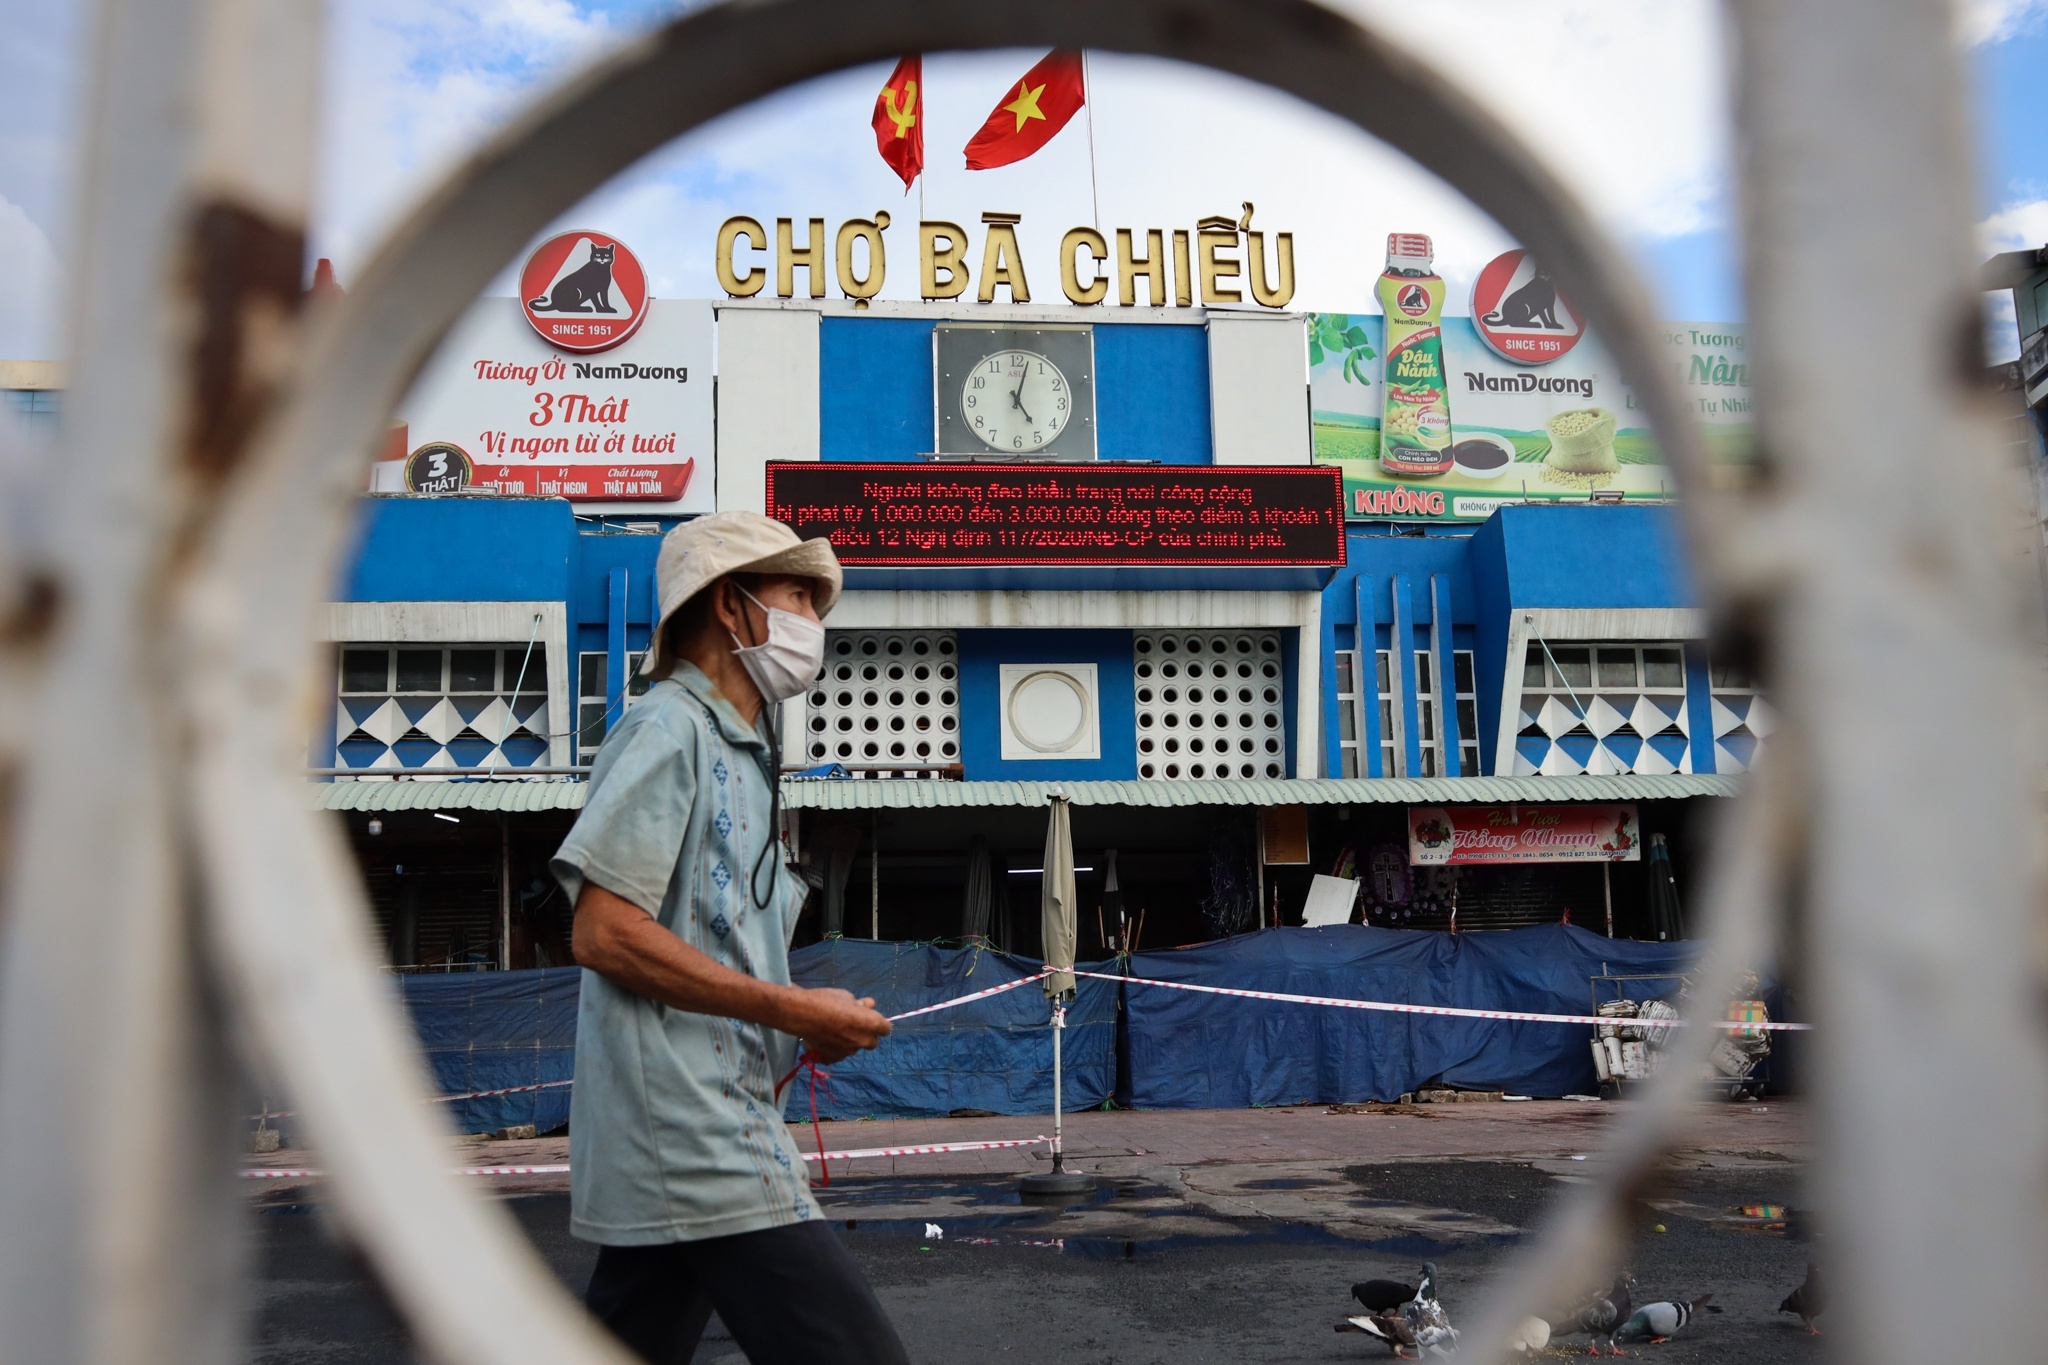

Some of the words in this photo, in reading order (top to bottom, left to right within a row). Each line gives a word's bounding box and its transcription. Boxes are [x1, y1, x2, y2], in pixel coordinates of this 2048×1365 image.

[715, 209, 891, 309] CHỢ
[552, 324, 584, 336] SINCE
[588, 325, 612, 336] 1951
[1506, 339, 1536, 350] SINCE
[1538, 340, 1561, 351] 1951
[1010, 355, 1024, 368] 12
[1401, 349, 1433, 366] Đậu
[474, 360, 538, 386] Tương
[542, 354, 566, 380] Ớt
[989, 360, 1001, 373] 11
[1038, 362, 1045, 374] 1
[1396, 362, 1438, 378] Nành
[1688, 354, 1753, 386] Nàn
[972, 376, 985, 389] 10
[1052, 378, 1061, 391] 2
[968, 395, 976, 408] 9
[1057, 398, 1066, 410] 3
[529, 392, 554, 426] 3
[558, 394, 630, 428] Thật
[975, 416, 984, 428] 8
[1049, 417, 1058, 430] 4
[988, 430, 997, 442] 7
[1014, 436, 1022, 448] 6
[1034, 431, 1042, 444] 5
[480, 430, 506, 458] Vị
[510, 437, 570, 460] ngon
[574, 432, 600, 454] từ
[604, 430, 626, 454] ớt
[631, 432, 677, 454] tươi
[428, 452, 448, 478] 3
[420, 476, 458, 492] THẬT
[564, 482, 588, 494] NGON
[603, 480, 624, 496] THẬT
[626, 482, 638, 494] AN
[640, 478, 662, 494] TOÀN
[1355, 484, 1445, 515] KHÔNG
[870, 504, 964, 522] 1.000.000
[1008, 505, 1101, 523] 3.000.000
[1324, 507, 1333, 524] 1
[877, 528, 900, 546] 12
[1452, 828, 1518, 852] Hồng
[1520, 828, 1598, 848] Nhung
